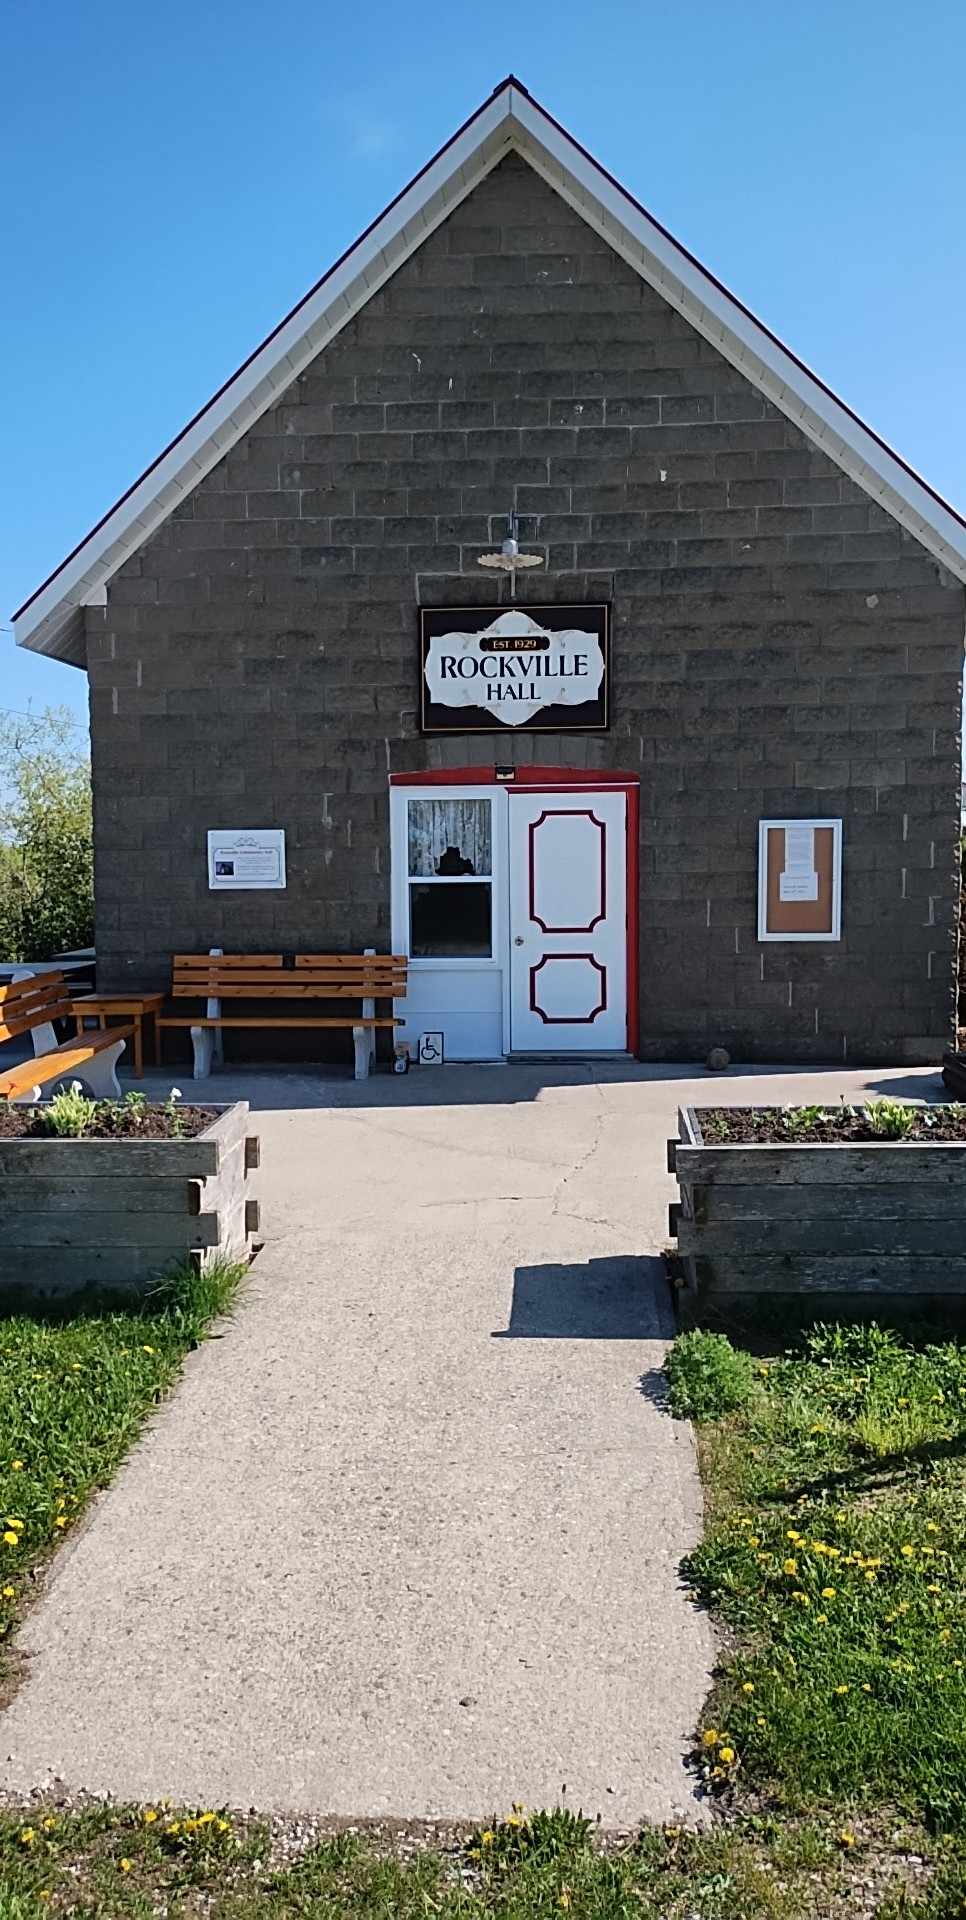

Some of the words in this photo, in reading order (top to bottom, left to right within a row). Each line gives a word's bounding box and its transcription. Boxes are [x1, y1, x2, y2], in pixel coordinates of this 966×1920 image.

[493, 640, 512, 649] EST.
[514, 639, 537, 649] 1929
[440, 655, 588, 678] ROCKVILLE
[487, 683, 541, 700] HALL
